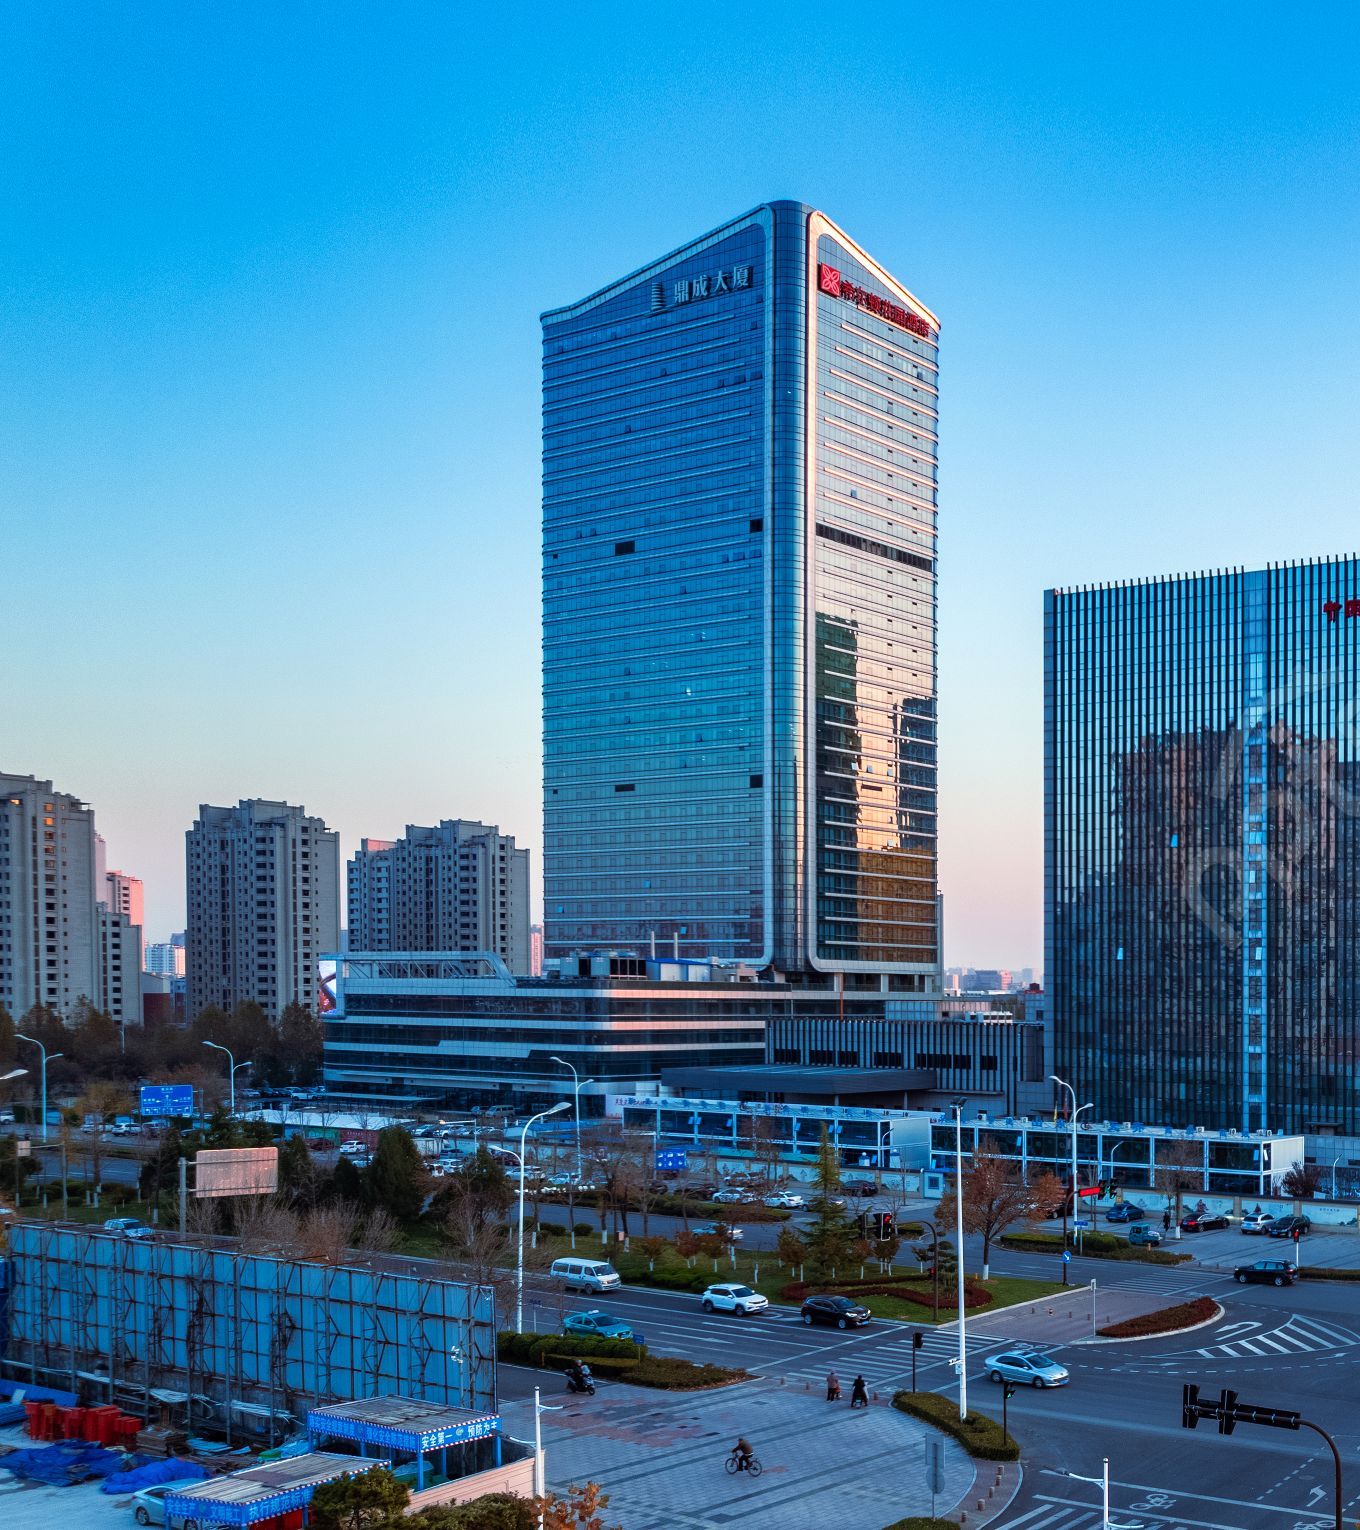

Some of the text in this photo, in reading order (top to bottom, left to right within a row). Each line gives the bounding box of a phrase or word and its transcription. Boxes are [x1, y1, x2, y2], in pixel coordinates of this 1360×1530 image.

[674, 265, 750, 303] 鼎成大厦
[840, 280, 930, 338] 希尔顿花园酒店
[421, 1432, 453, 1449] 安全第一
[249, 1491, 311, 1518] 执行规范标准
